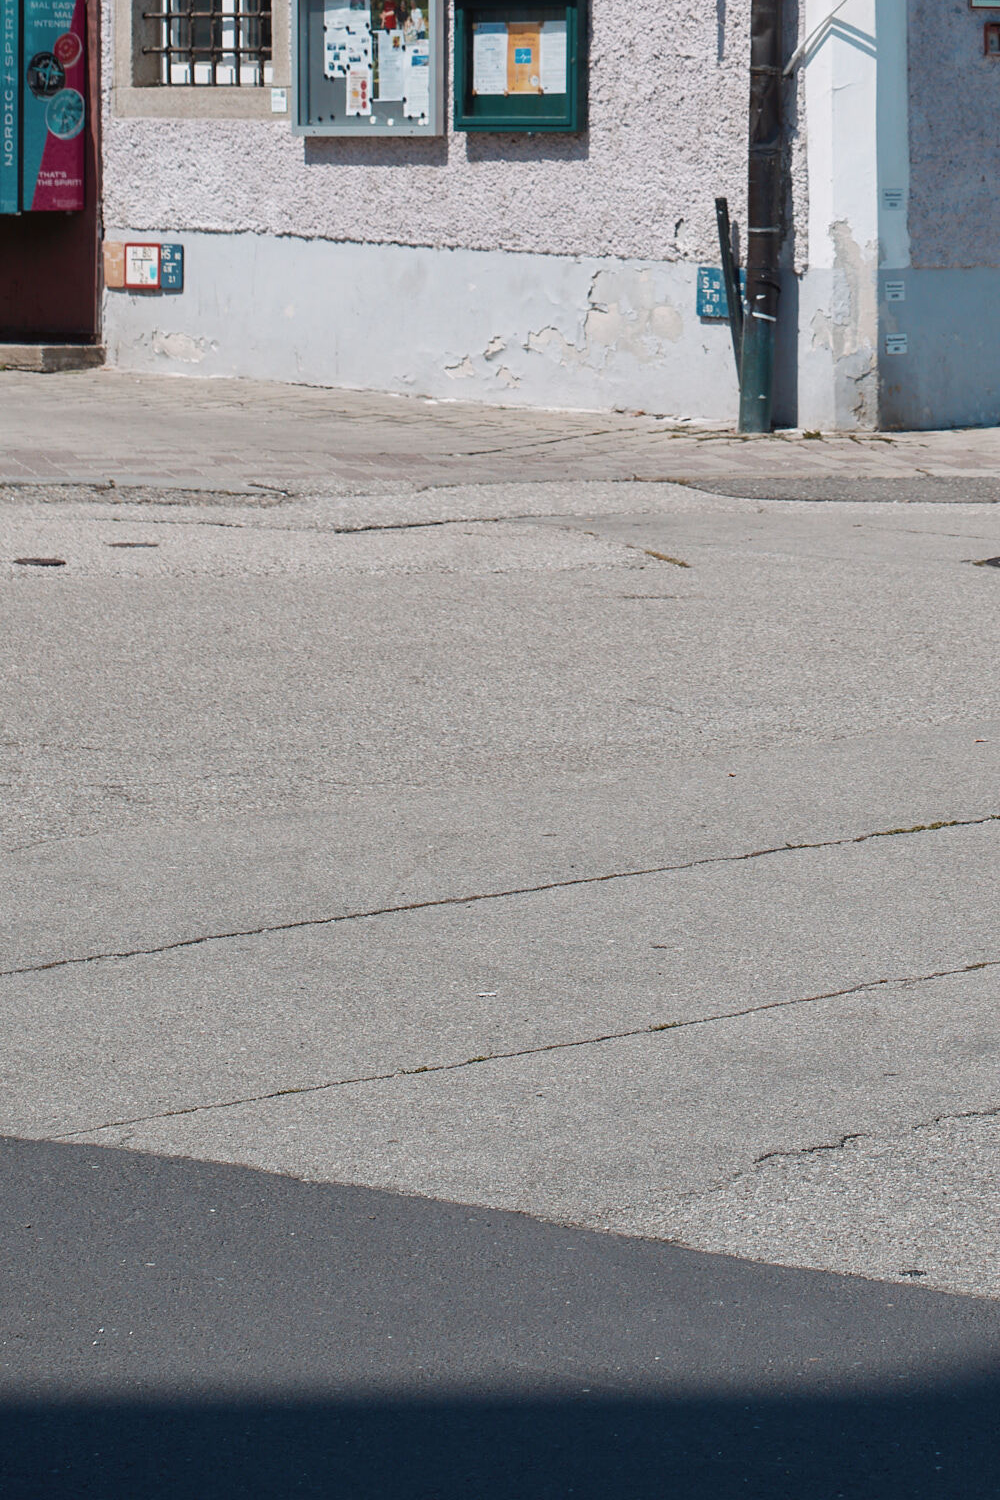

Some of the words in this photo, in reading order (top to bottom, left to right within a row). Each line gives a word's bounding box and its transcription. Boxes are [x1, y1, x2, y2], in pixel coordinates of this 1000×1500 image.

[30, 1, 50, 10] MAL
[52, 1, 76, 11] EASY
[54, 11, 73, 19] MAL
[4, 89, 14, 167] NORDIC
